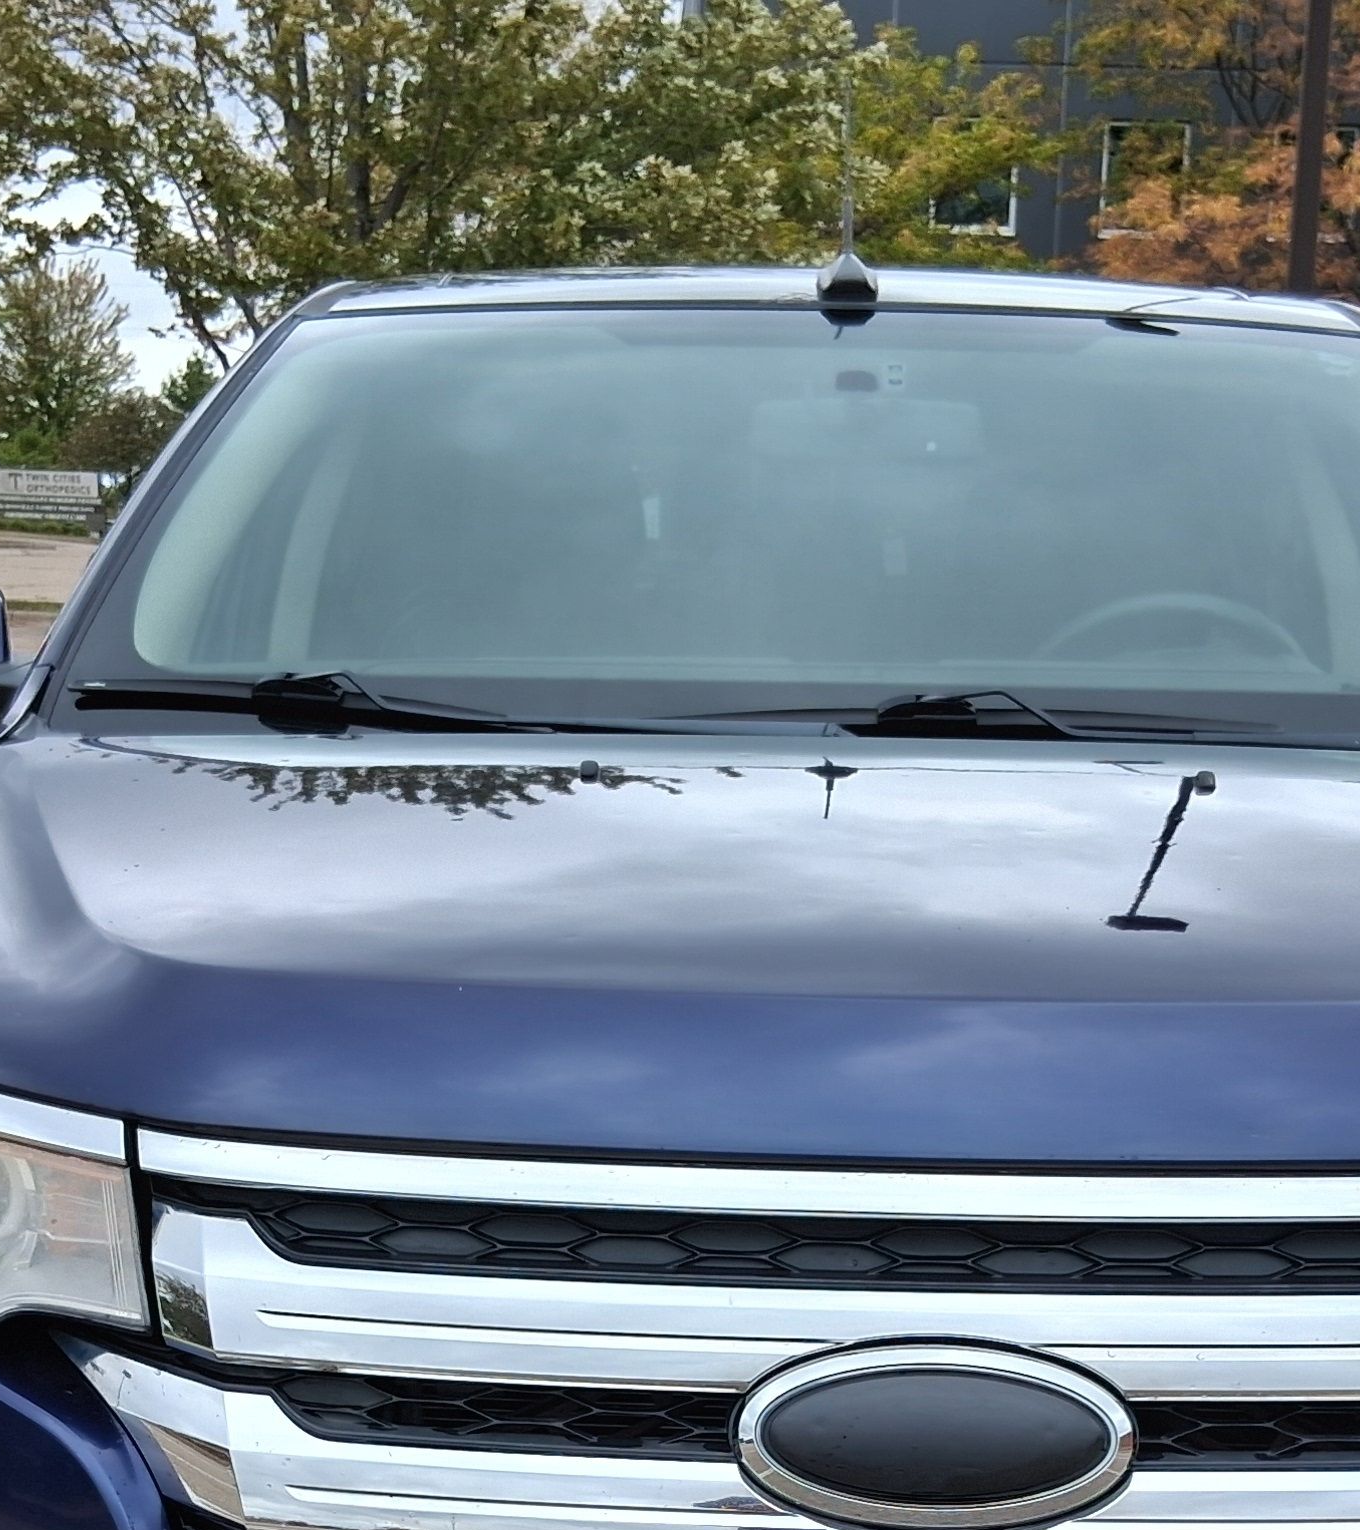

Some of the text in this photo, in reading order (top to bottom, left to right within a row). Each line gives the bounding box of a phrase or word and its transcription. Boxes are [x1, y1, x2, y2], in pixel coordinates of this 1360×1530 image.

[26, 473, 81, 483] TWIN CITIES
[27, 485, 91, 495] ORTHOPEDICS
